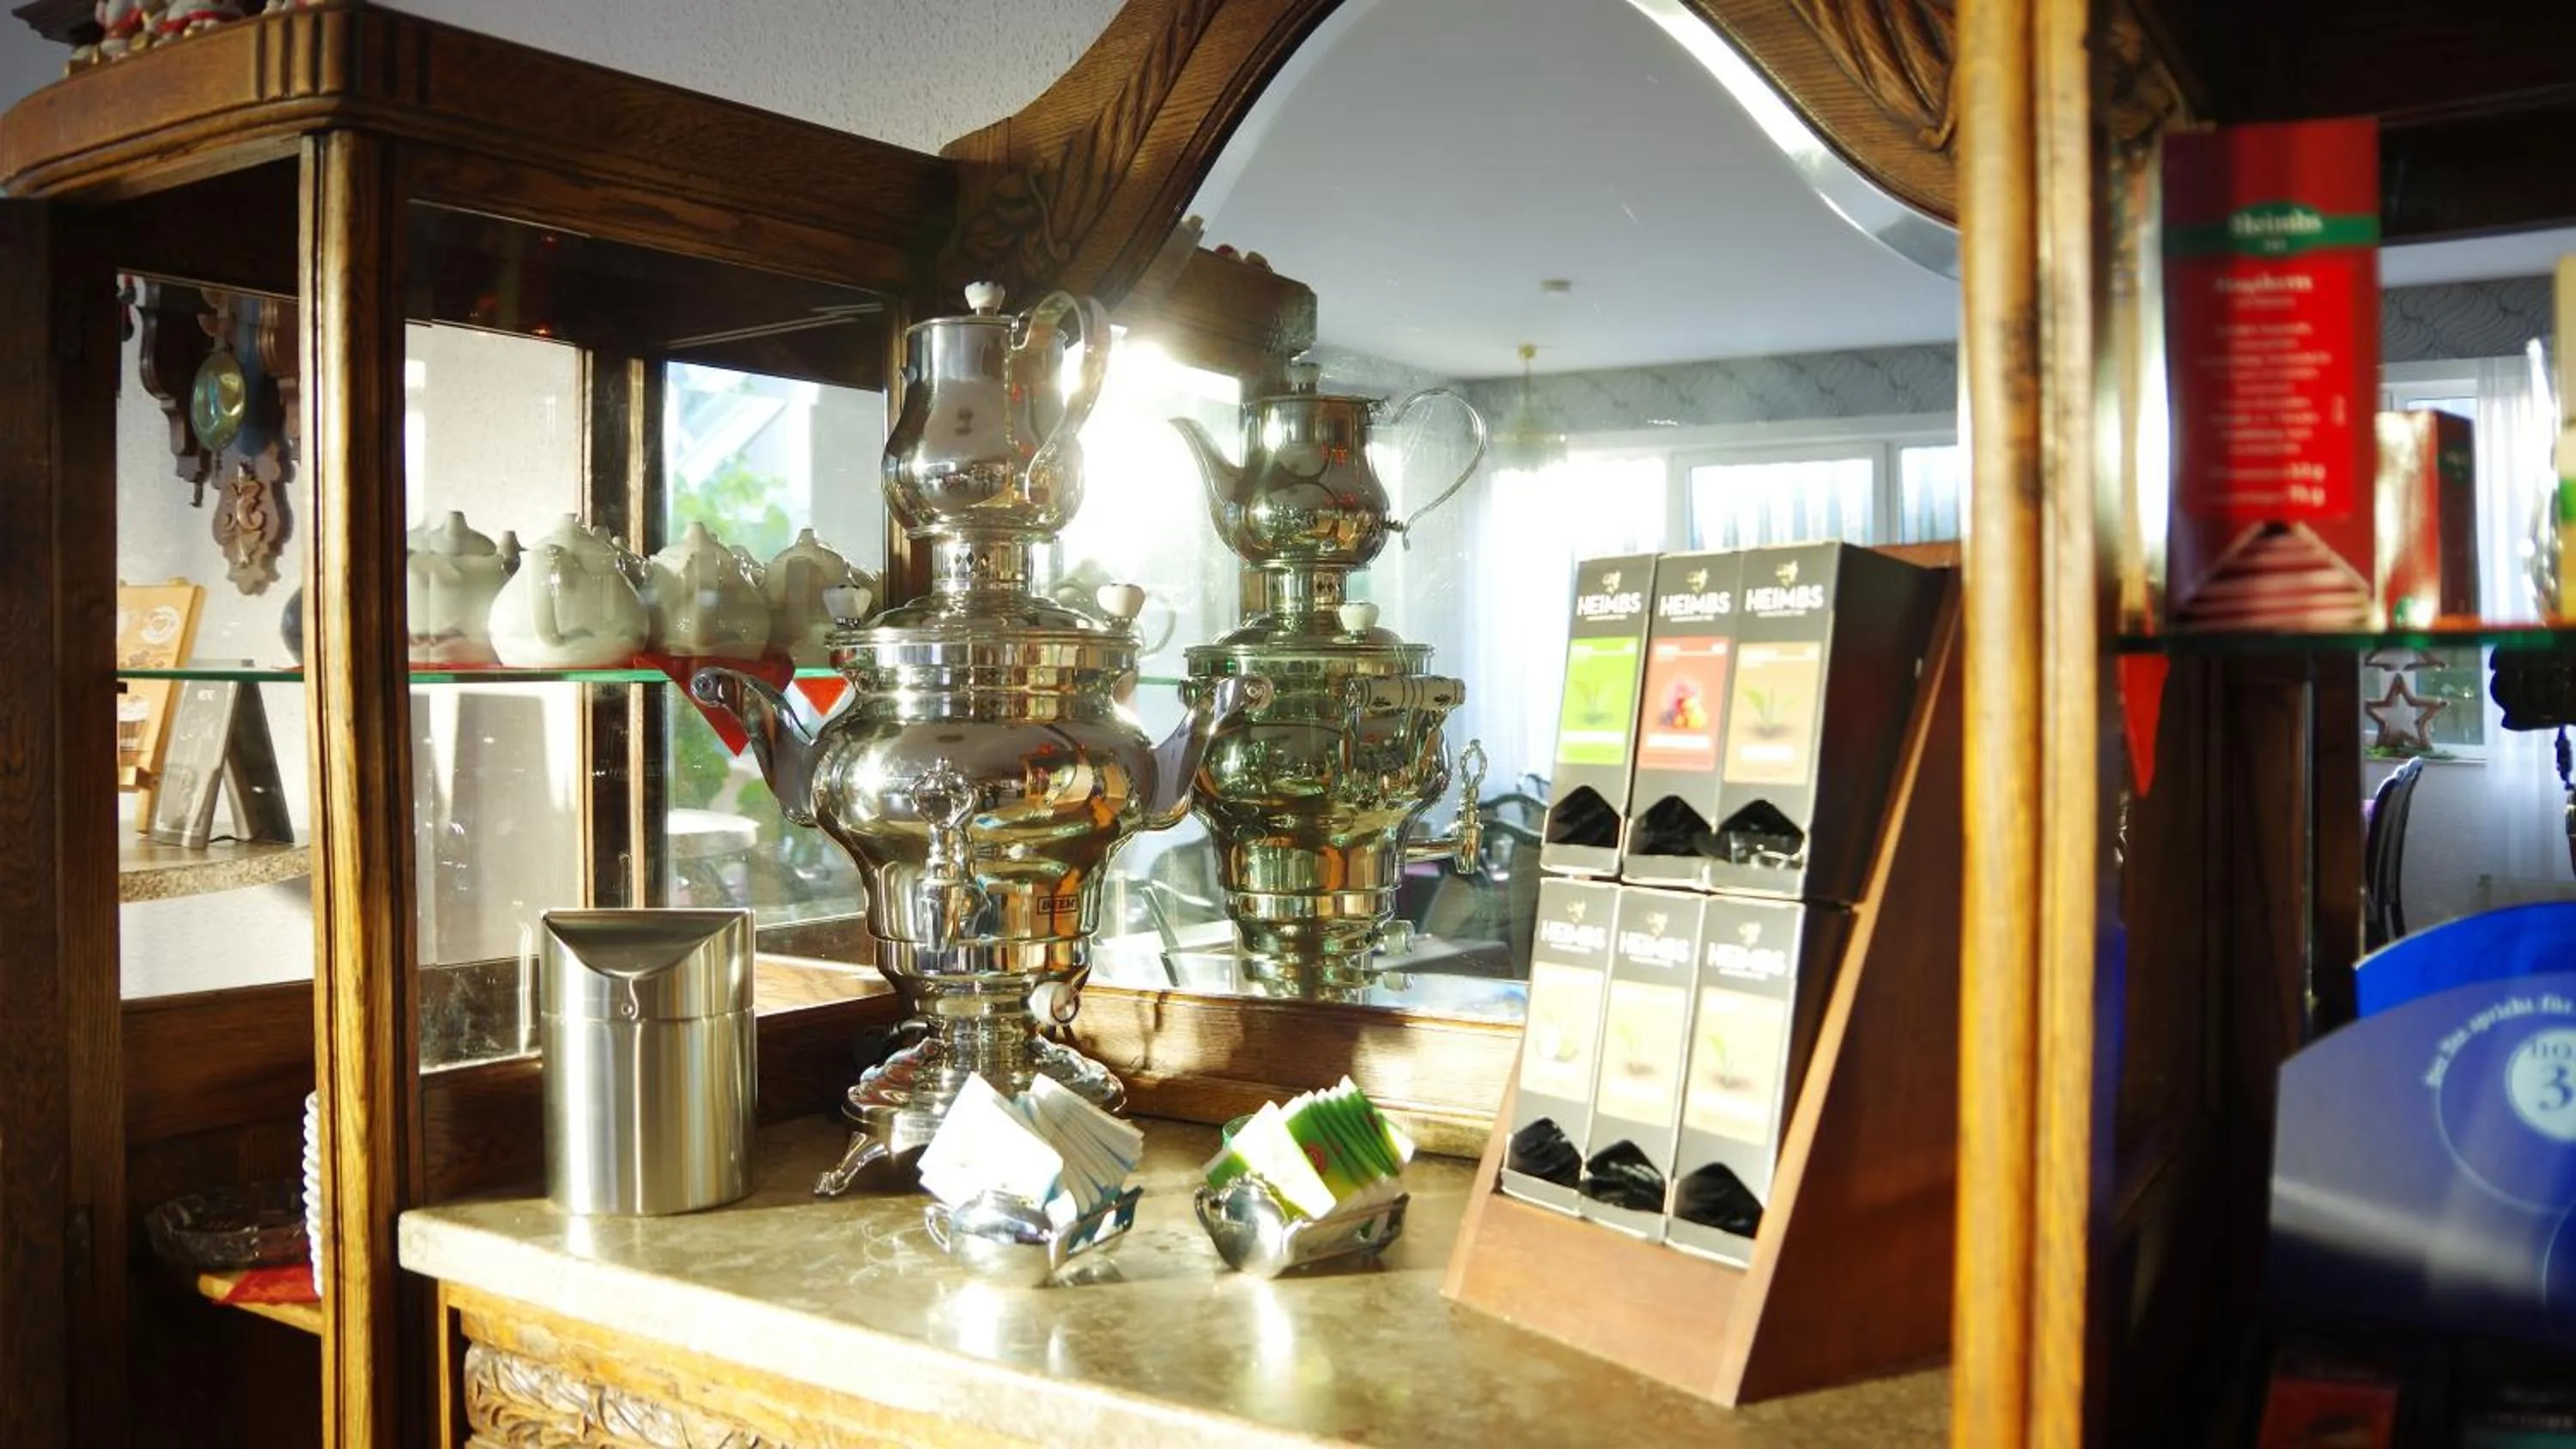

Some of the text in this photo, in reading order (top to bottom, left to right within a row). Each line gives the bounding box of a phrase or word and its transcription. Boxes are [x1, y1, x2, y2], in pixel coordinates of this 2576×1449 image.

[1577, 591, 1642, 616] HEIMBS
[1659, 591, 1731, 617] HEIMBS
[1745, 585, 1825, 613] HEIMBS
[2538, 1064, 2573, 1112] 3
